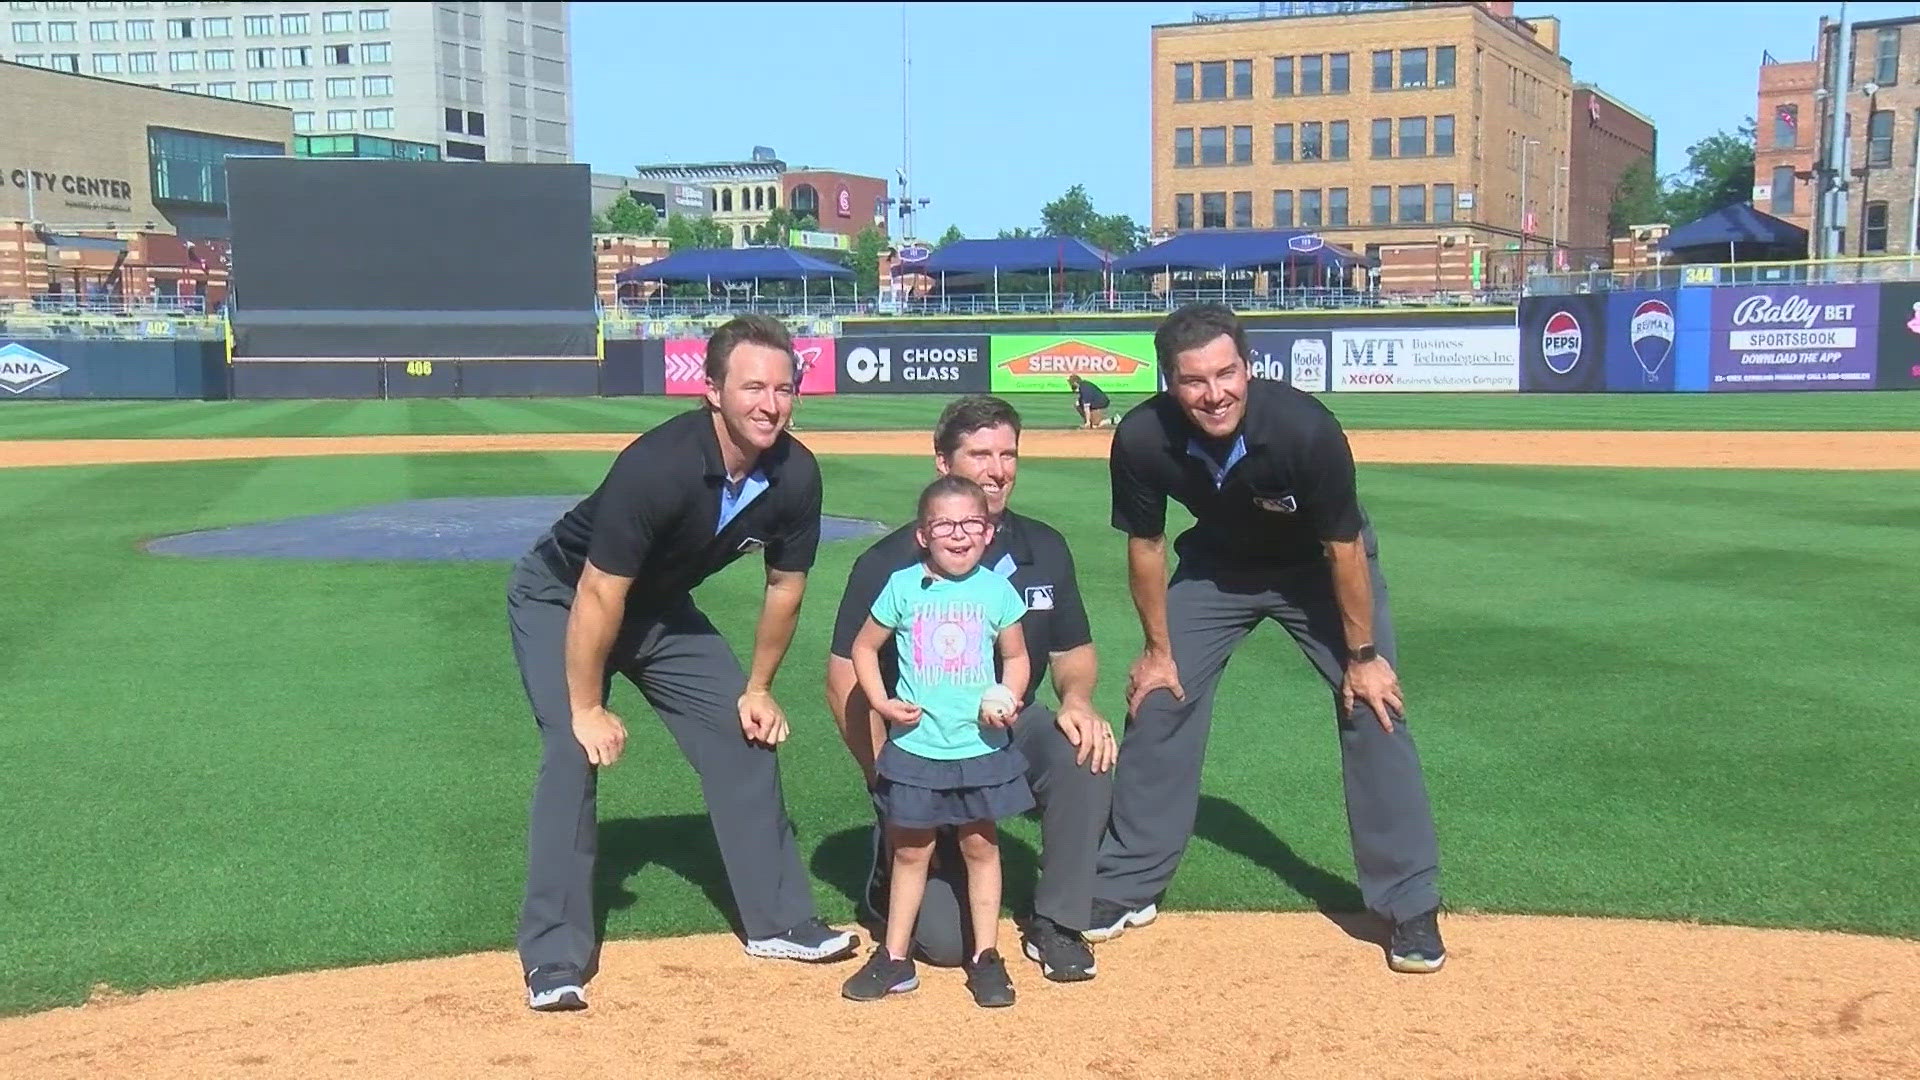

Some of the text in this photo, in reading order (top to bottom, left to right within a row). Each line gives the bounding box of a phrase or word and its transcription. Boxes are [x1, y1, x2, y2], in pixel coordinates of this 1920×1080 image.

[61, 175, 131, 200] CENTER
[1686, 267, 1713, 283] 344
[1733, 295, 1855, 329] Bally BET
[1412, 338, 1464, 349] Business
[1545, 337, 1579, 350] PEPSI
[1749, 332, 1836, 347] SPORTSBOOK
[902, 348, 978, 363] CHOOSE
[1342, 339, 1404, 367] MT
[1494, 353, 1516, 363] Inc.
[1740, 352, 1842, 365] DOWNLOAD THE APP
[0, 363, 43, 374] ANA
[1028, 355, 1118, 372] SERVPRO
[902, 367, 960, 380] GLASS
[1349, 373, 1394, 385] xerox
[1473, 376, 1513, 386] Company
[913, 601, 987, 621] TOLEDO
